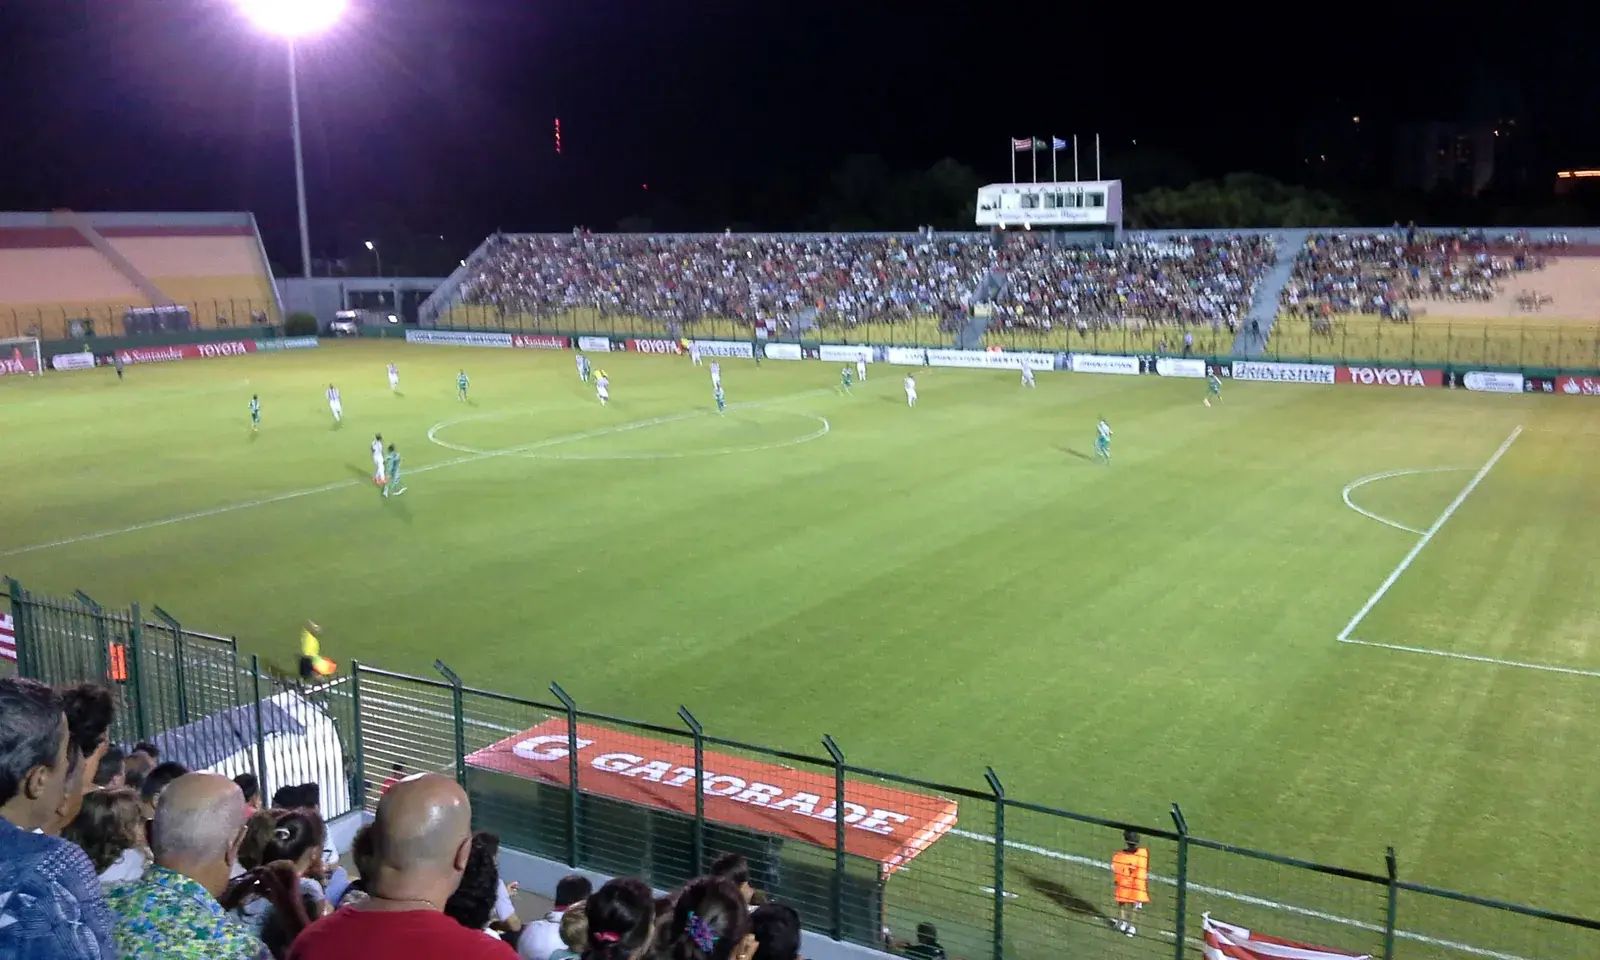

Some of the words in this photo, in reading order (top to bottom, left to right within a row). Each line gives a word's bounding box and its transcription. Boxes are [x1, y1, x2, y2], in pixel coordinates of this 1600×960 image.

[197, 341, 247, 358] TOYOTA
[522, 335, 563, 350] Santander
[634, 339, 681, 354] TOYOTA
[132, 347, 184, 363] Santander
[1235, 364, 1333, 383] BRIDGESTONE
[1349, 367, 1425, 387] TOYOTA
[512, 735, 594, 761] G
[591, 753, 914, 835] GATORADE
